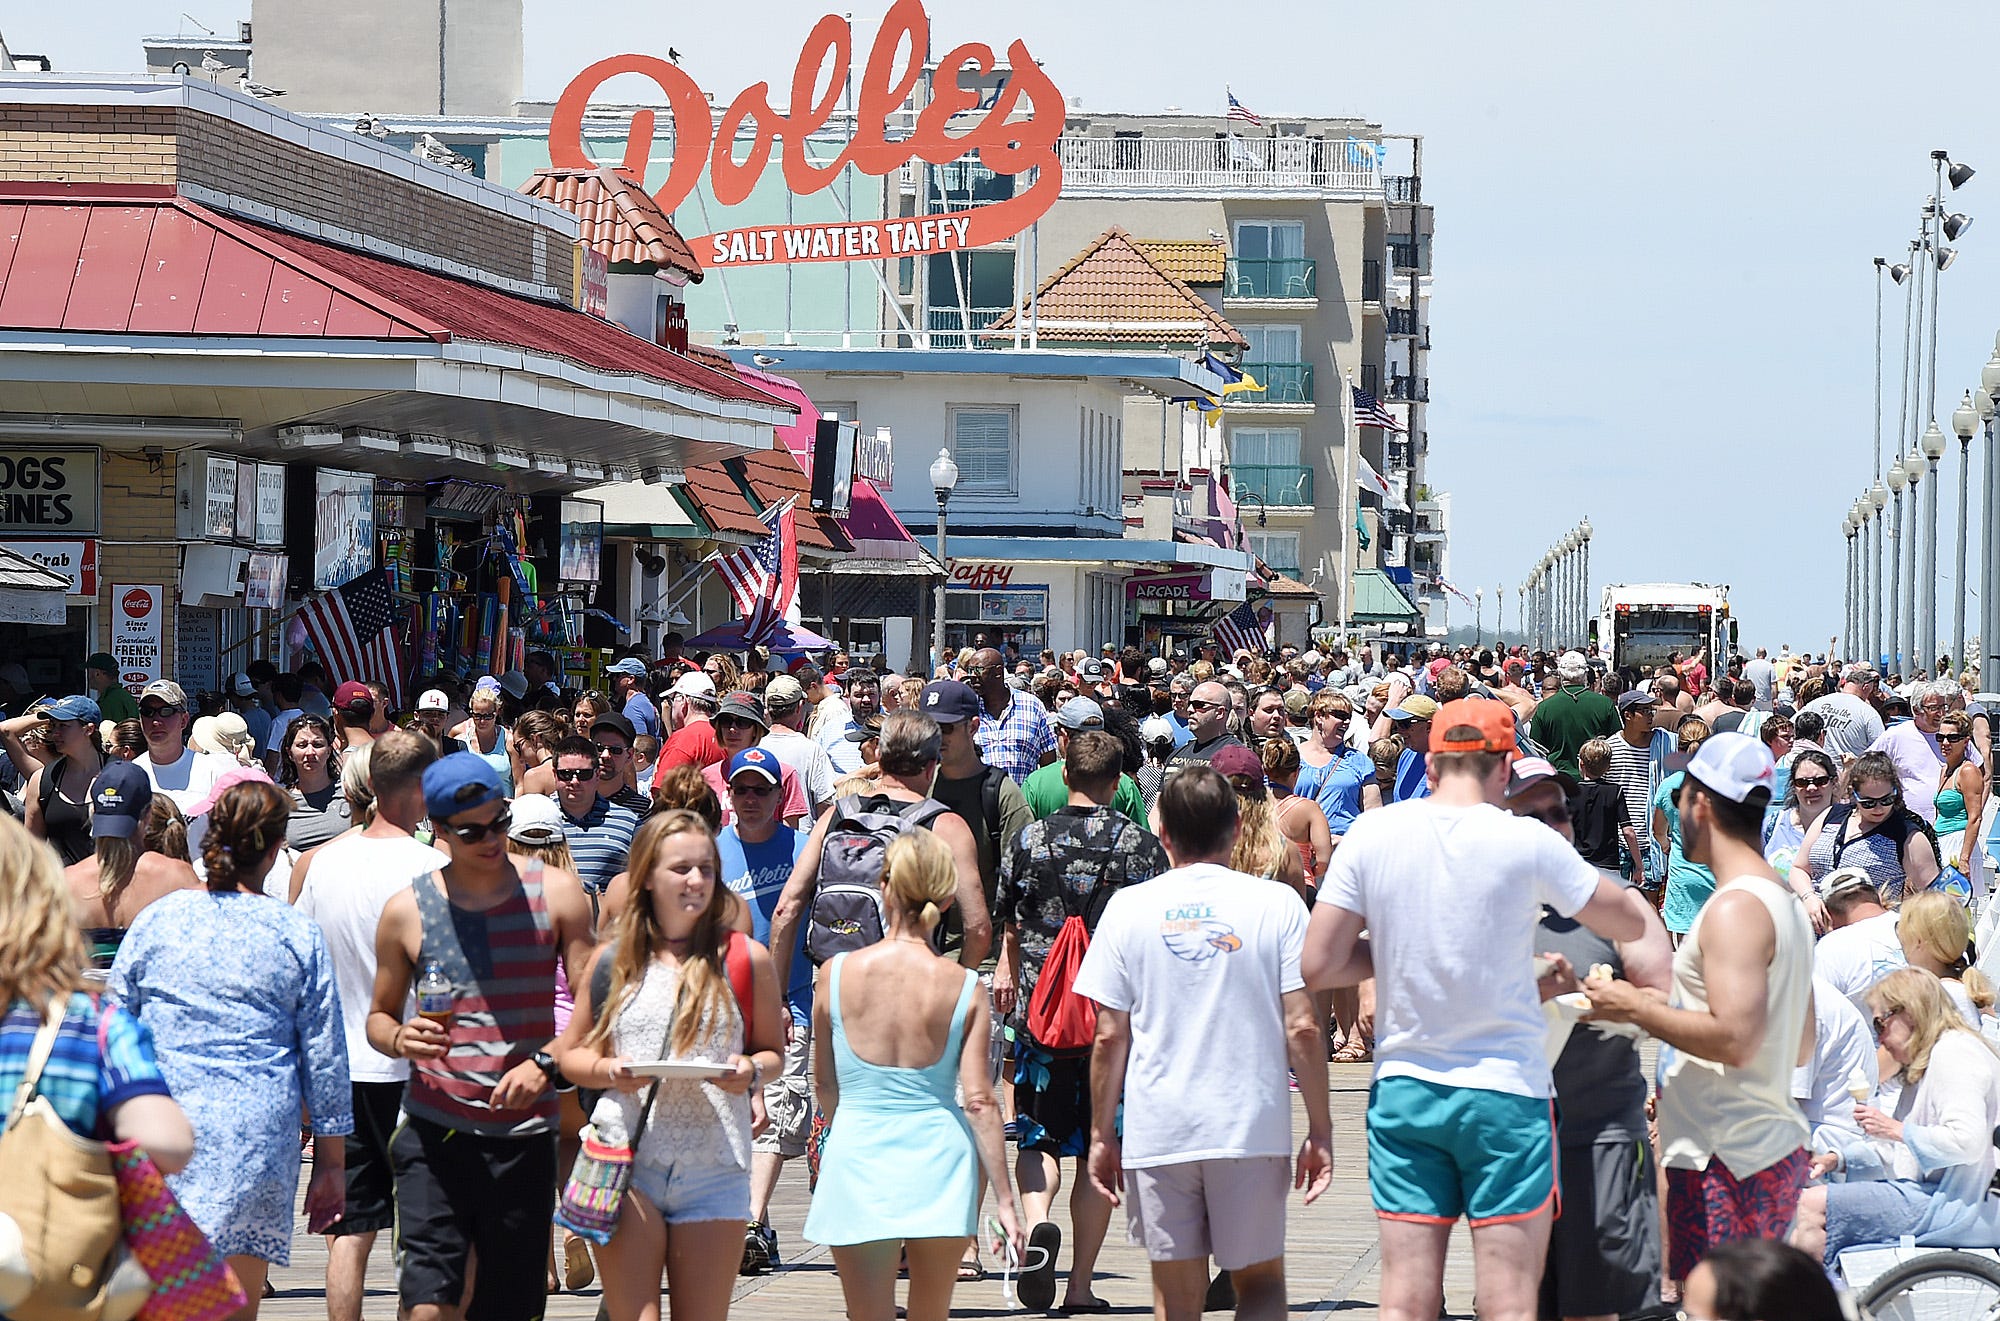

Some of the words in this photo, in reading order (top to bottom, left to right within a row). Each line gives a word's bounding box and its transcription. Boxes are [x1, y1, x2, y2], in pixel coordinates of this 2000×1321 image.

[712, 229, 778, 263] SALT
[782, 225, 881, 259] WATER
[885, 216, 971, 253] TAFFY
[0, 494, 73, 525] INES
[32, 552, 70, 567] Crab
[1136, 584, 1190, 598] ARCADE
[124, 599, 150, 609] Coca-Cola
[196, 611, 213, 619] GUS
[116, 635, 156, 644] Boardwalk
[115, 645, 158, 656] FRENCH
[120, 657, 152, 668] FRIES
[1821, 703, 1840, 715] Pass
[1166, 906, 1217, 920] EAGLE
